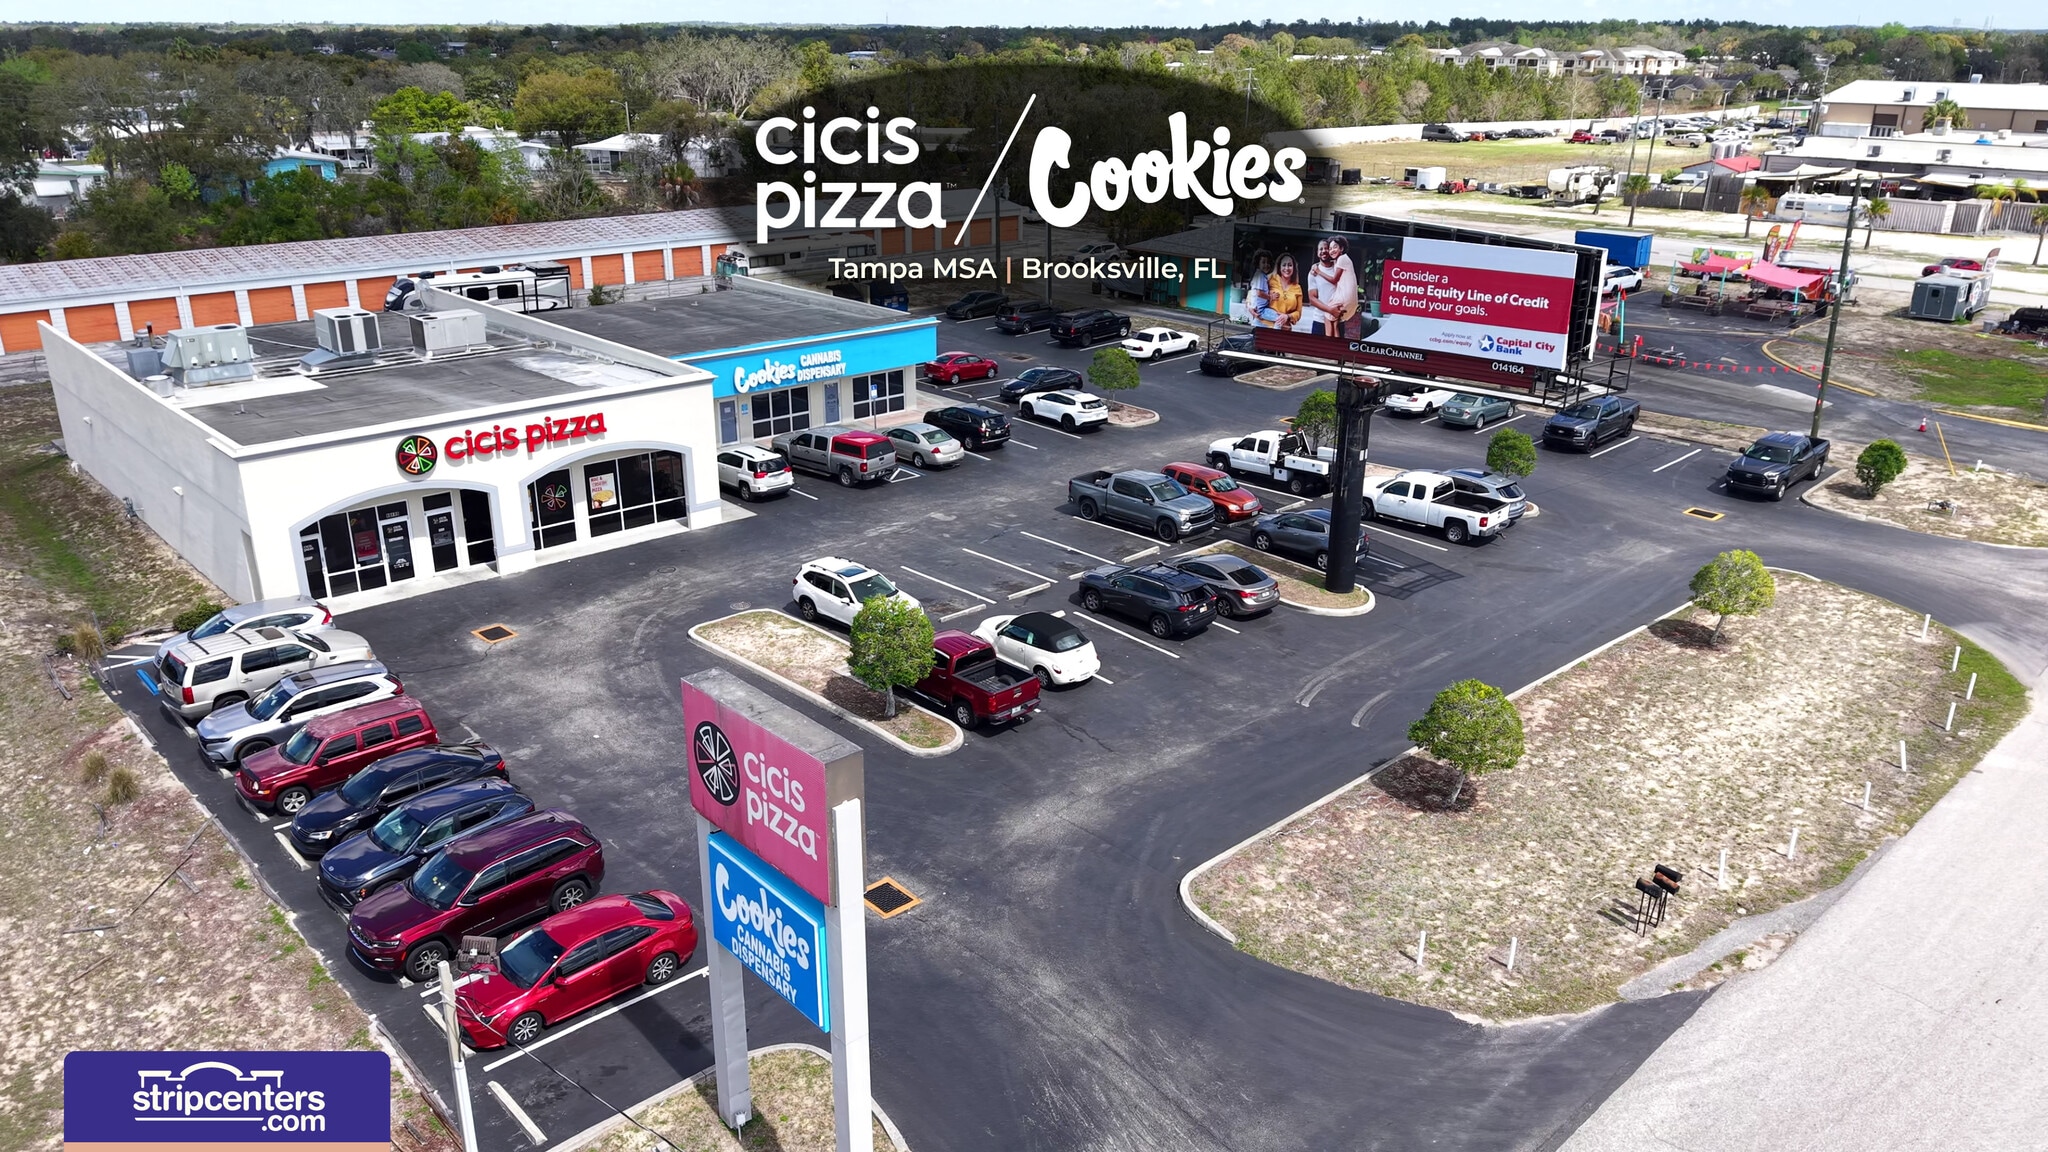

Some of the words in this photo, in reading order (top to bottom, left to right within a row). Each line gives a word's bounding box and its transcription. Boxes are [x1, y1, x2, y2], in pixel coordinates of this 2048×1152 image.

[1391, 267, 1440, 283] Consider
[1441, 275, 1449, 284] a
[1389, 295, 1400, 306] to
[1402, 296, 1427, 309] fund
[1428, 301, 1453, 312] your
[1455, 304, 1488, 316] goals.
[1390, 281, 1425, 295] Home
[1427, 285, 1465, 301] Equity
[1467, 289, 1493, 302] Line
[1494, 293, 1509, 304] of
[1509, 294, 1550, 309] Credit
[1442, 331, 1456, 339] Apply
[1496, 336, 1532, 349] Capital
[1535, 341, 1556, 353] City
[800, 350, 842, 367] CANNABIS
[1496, 345, 1523, 355] Bank
[734, 358, 796, 394] Cookies
[797, 362, 847, 382] DISPENSARY
[1491, 361, 1525, 375] 014164
[444, 425, 520, 460] cicis
[526, 412, 608, 453] pizza
[743, 751, 806, 812] cicis
[746, 787, 818, 861] pizza
[715, 862, 810, 970] Cookies
[737, 924, 791, 982] CANNABIS
[731, 936, 797, 1004] DISPENSARY
